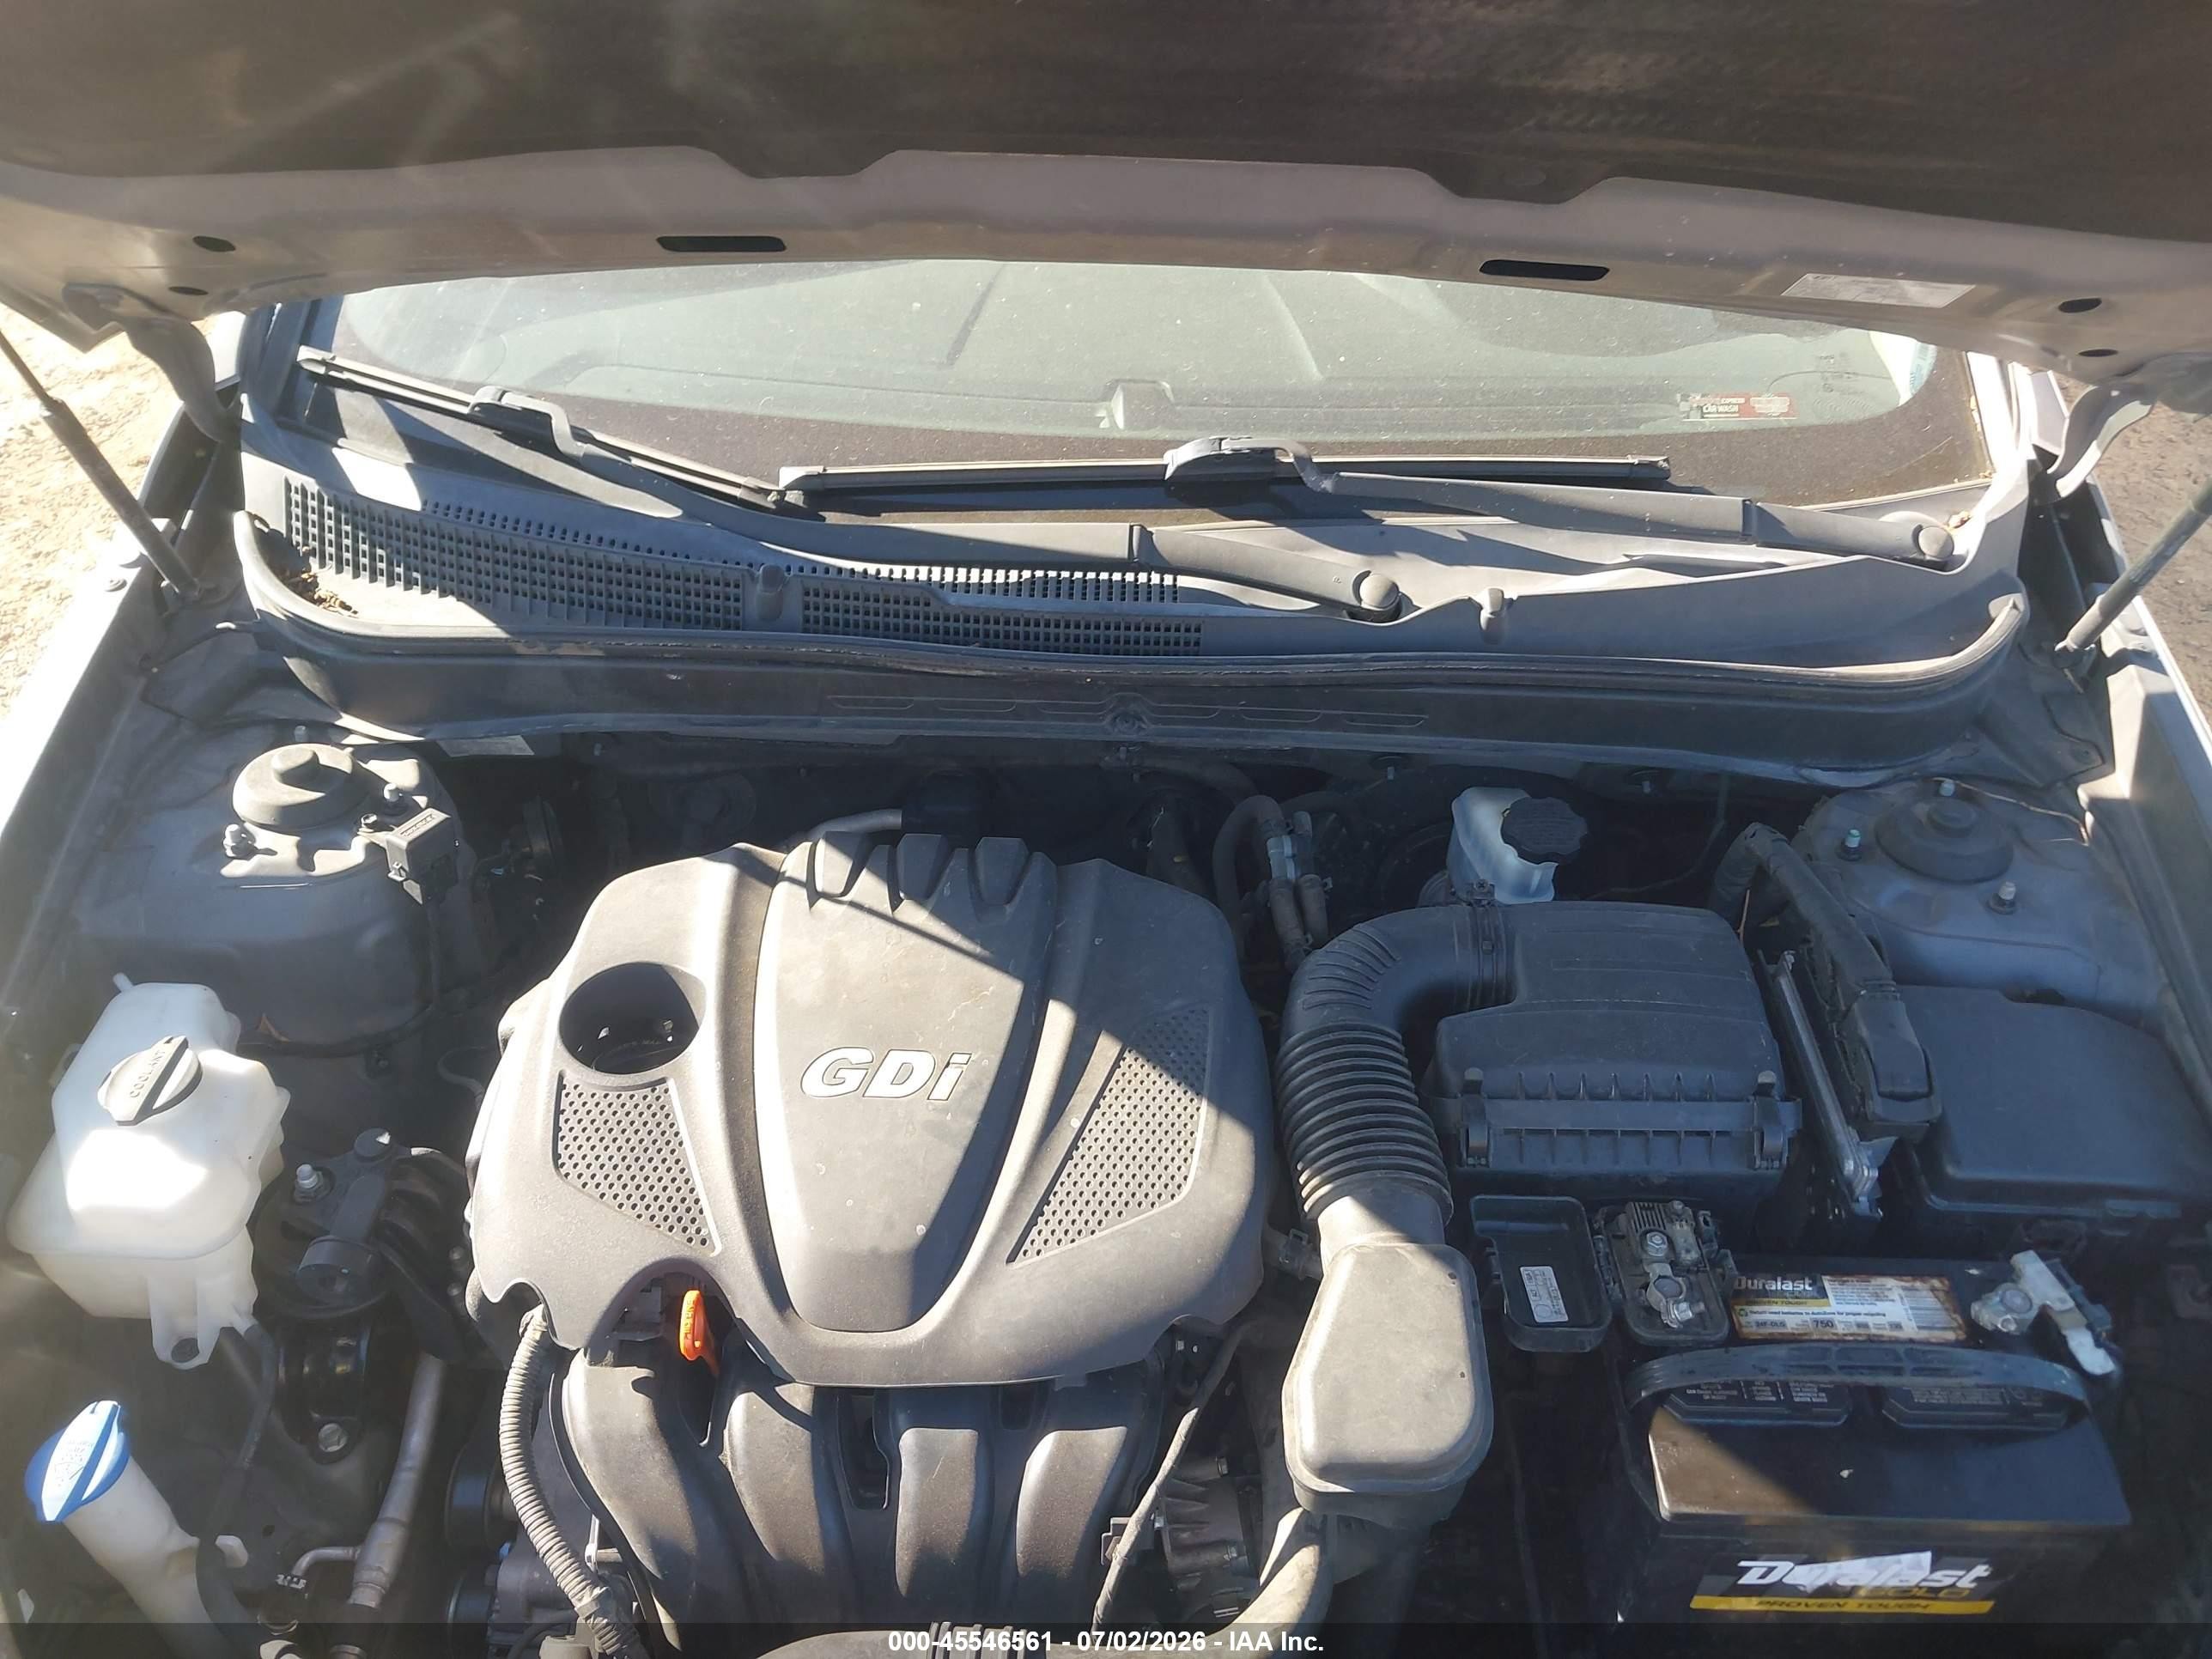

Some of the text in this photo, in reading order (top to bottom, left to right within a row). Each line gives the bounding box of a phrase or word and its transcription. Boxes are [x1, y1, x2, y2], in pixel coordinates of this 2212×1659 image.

[129, 1049, 166, 1098] COOLANT
[800, 1046, 972, 1101] GDi
[1735, 1275, 1813, 1291] Duralast
[1813, 1319, 1834, 1328] 750
[1754, 1599, 1931, 1610] PROVEN TOUGH
